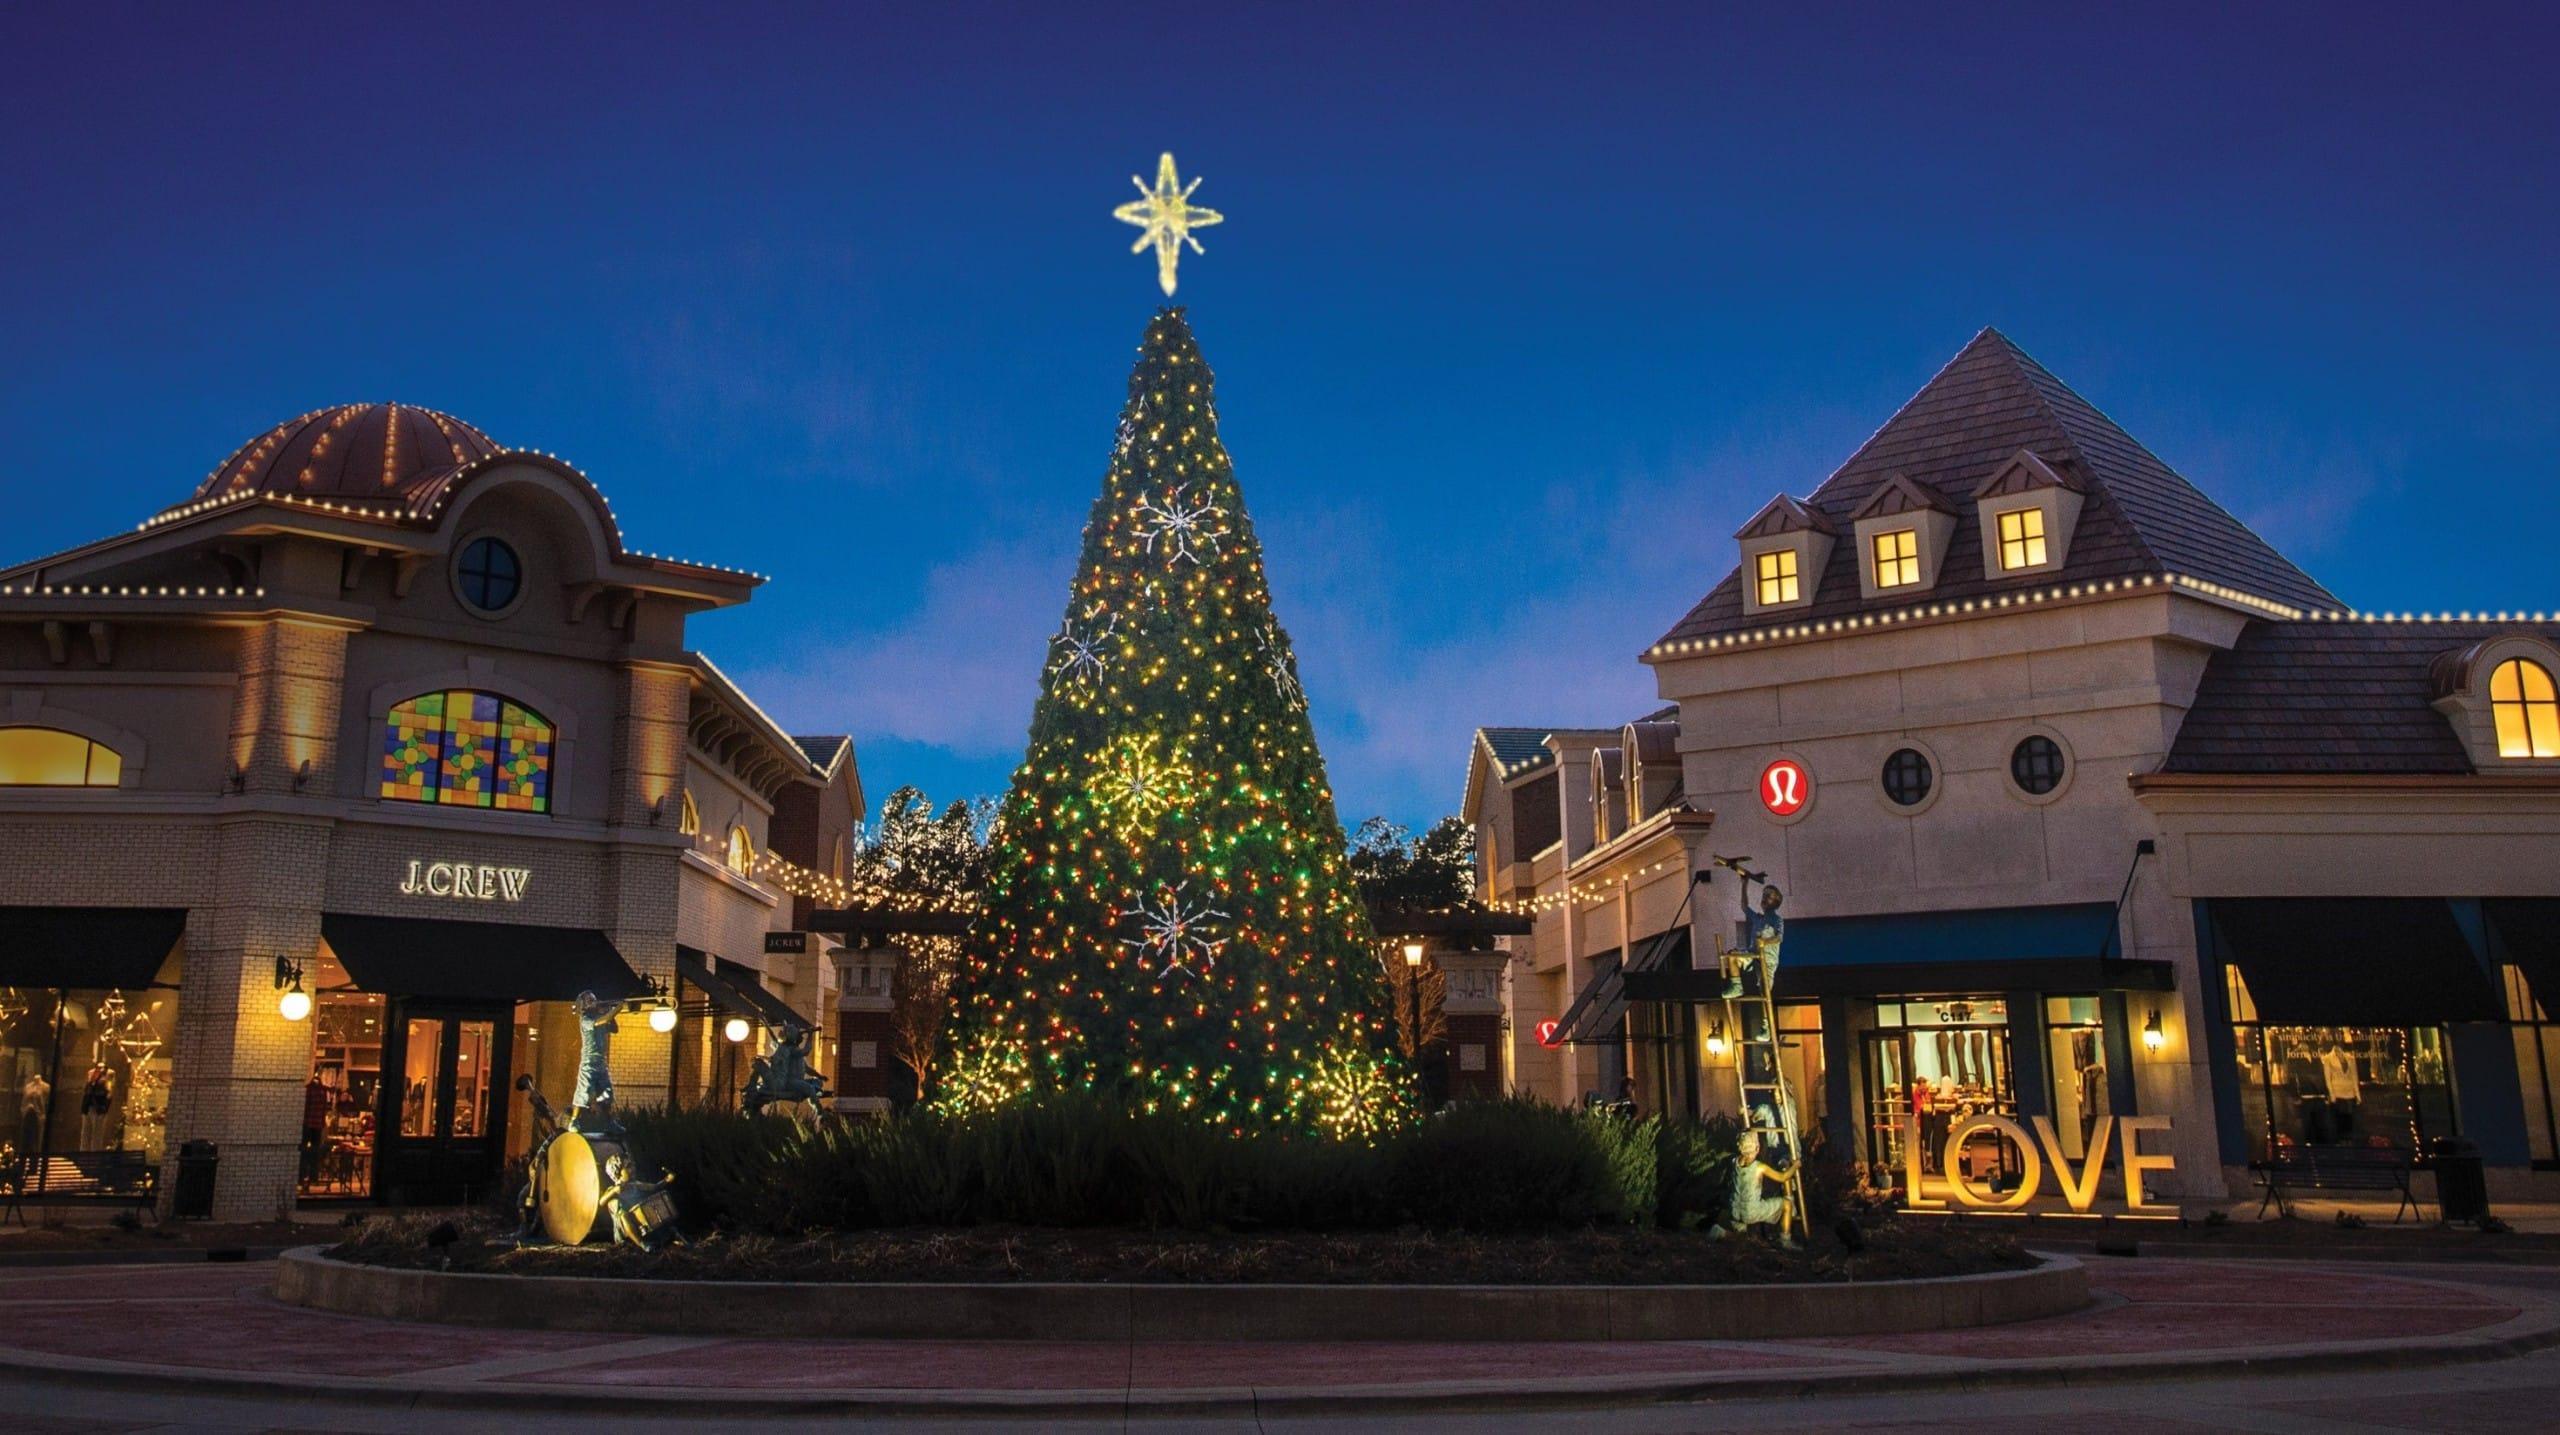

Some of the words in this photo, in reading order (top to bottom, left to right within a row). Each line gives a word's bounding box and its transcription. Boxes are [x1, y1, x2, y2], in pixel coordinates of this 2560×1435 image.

[400, 860, 531, 901] J.CREW
[1940, 1011, 1971, 1022] C117
[1903, 1115, 2180, 1212] LOVE
